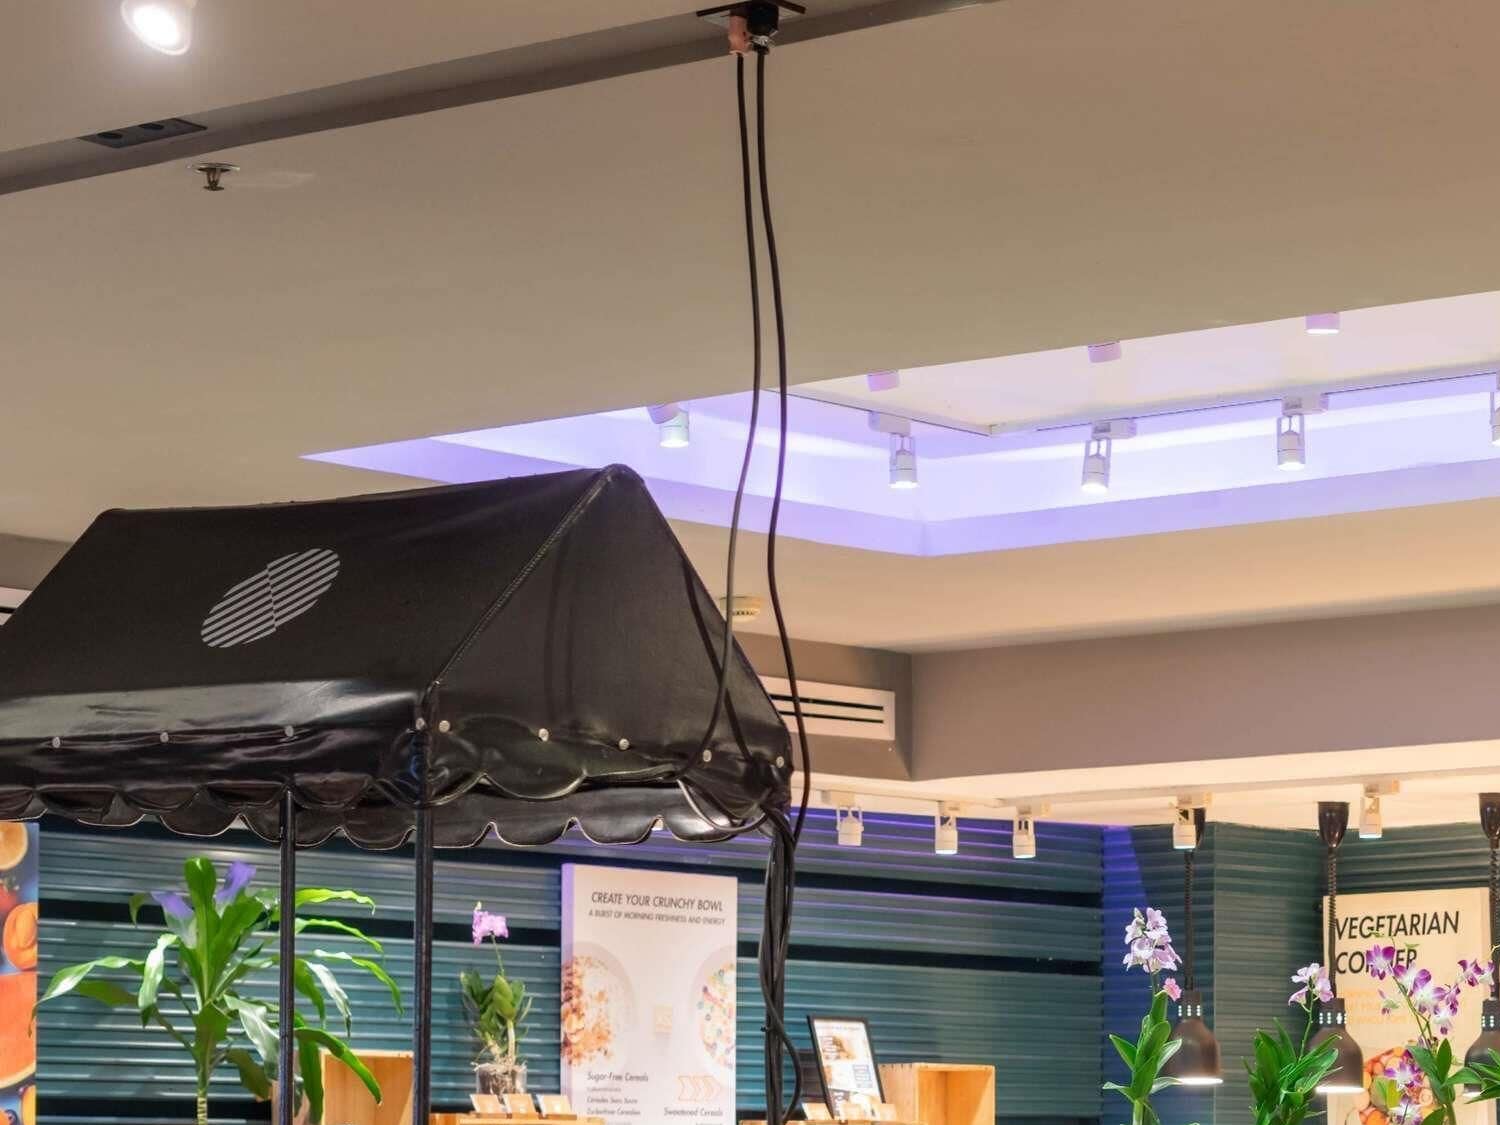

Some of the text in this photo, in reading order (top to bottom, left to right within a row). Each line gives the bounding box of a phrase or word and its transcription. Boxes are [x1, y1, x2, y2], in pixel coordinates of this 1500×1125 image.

[592, 892, 722, 911] CREATE YOUR CRUNCHY BOWL
[1335, 911, 1459, 940] VEGETARIAN
[1336, 948, 1417, 974] COER
